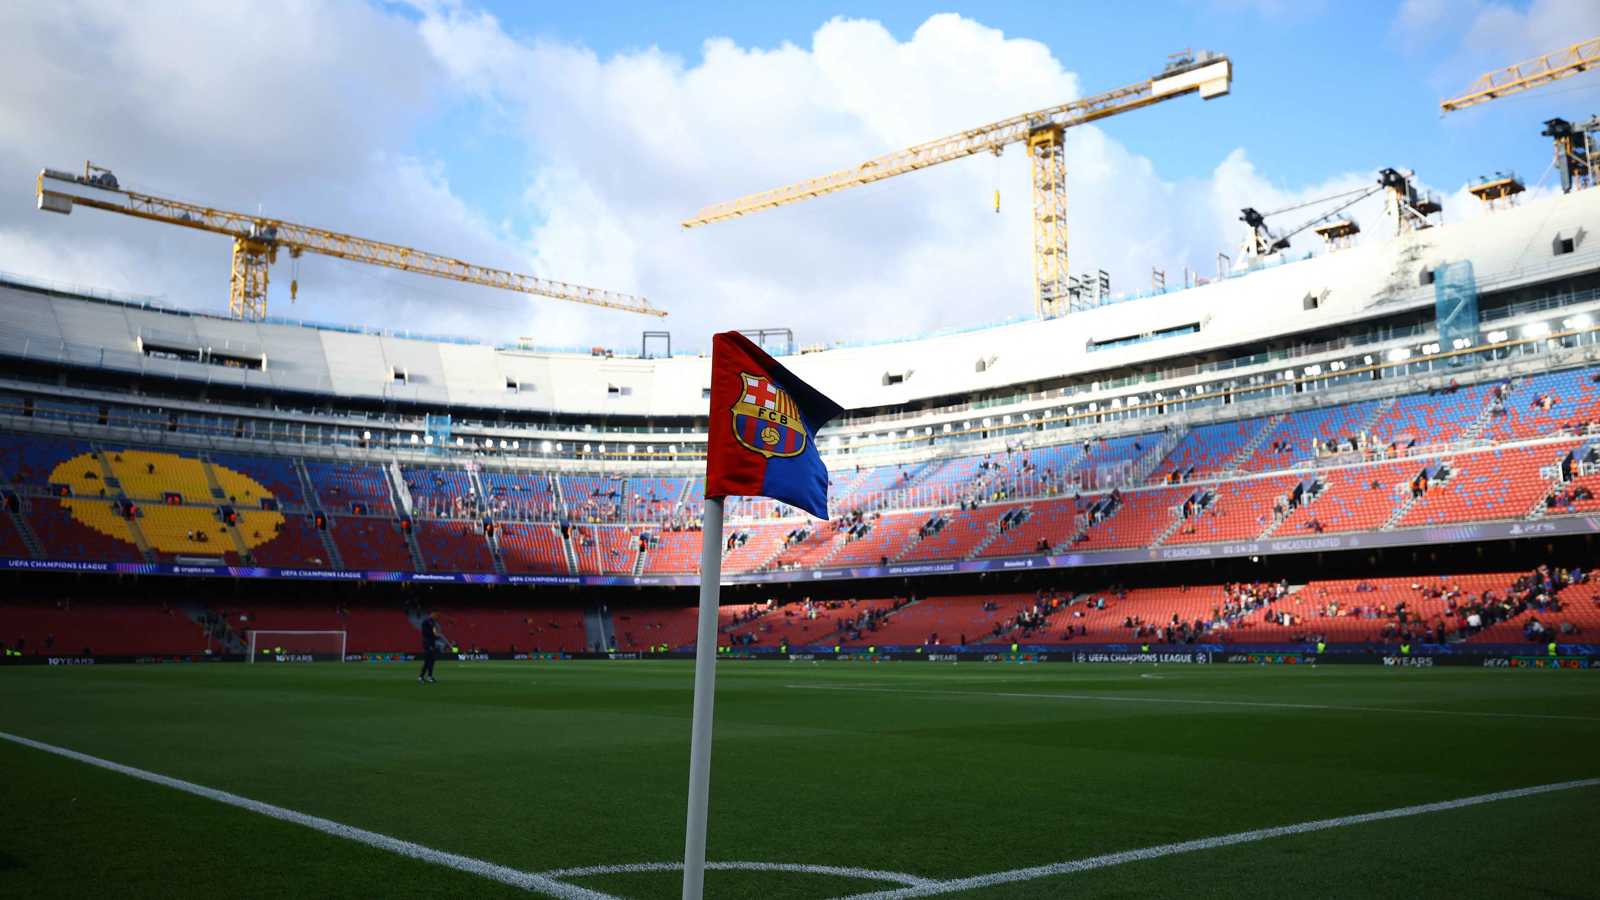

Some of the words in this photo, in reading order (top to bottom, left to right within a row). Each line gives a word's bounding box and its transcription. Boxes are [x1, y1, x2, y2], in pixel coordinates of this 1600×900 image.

[758, 408, 788, 425] FCB
[8, 560, 29, 568] UEFA
[31, 560, 77, 570] CHAMPIONS
[78, 562, 108, 571] LEAGUE
[299, 570, 336, 578] CHAMPIONS
[337, 571, 361, 579] LEAGUE
[1088, 654, 1109, 663] UEFA
[1110, 654, 1158, 663] CHAMPIONS
[1160, 654, 1192, 663] LEAGUE
